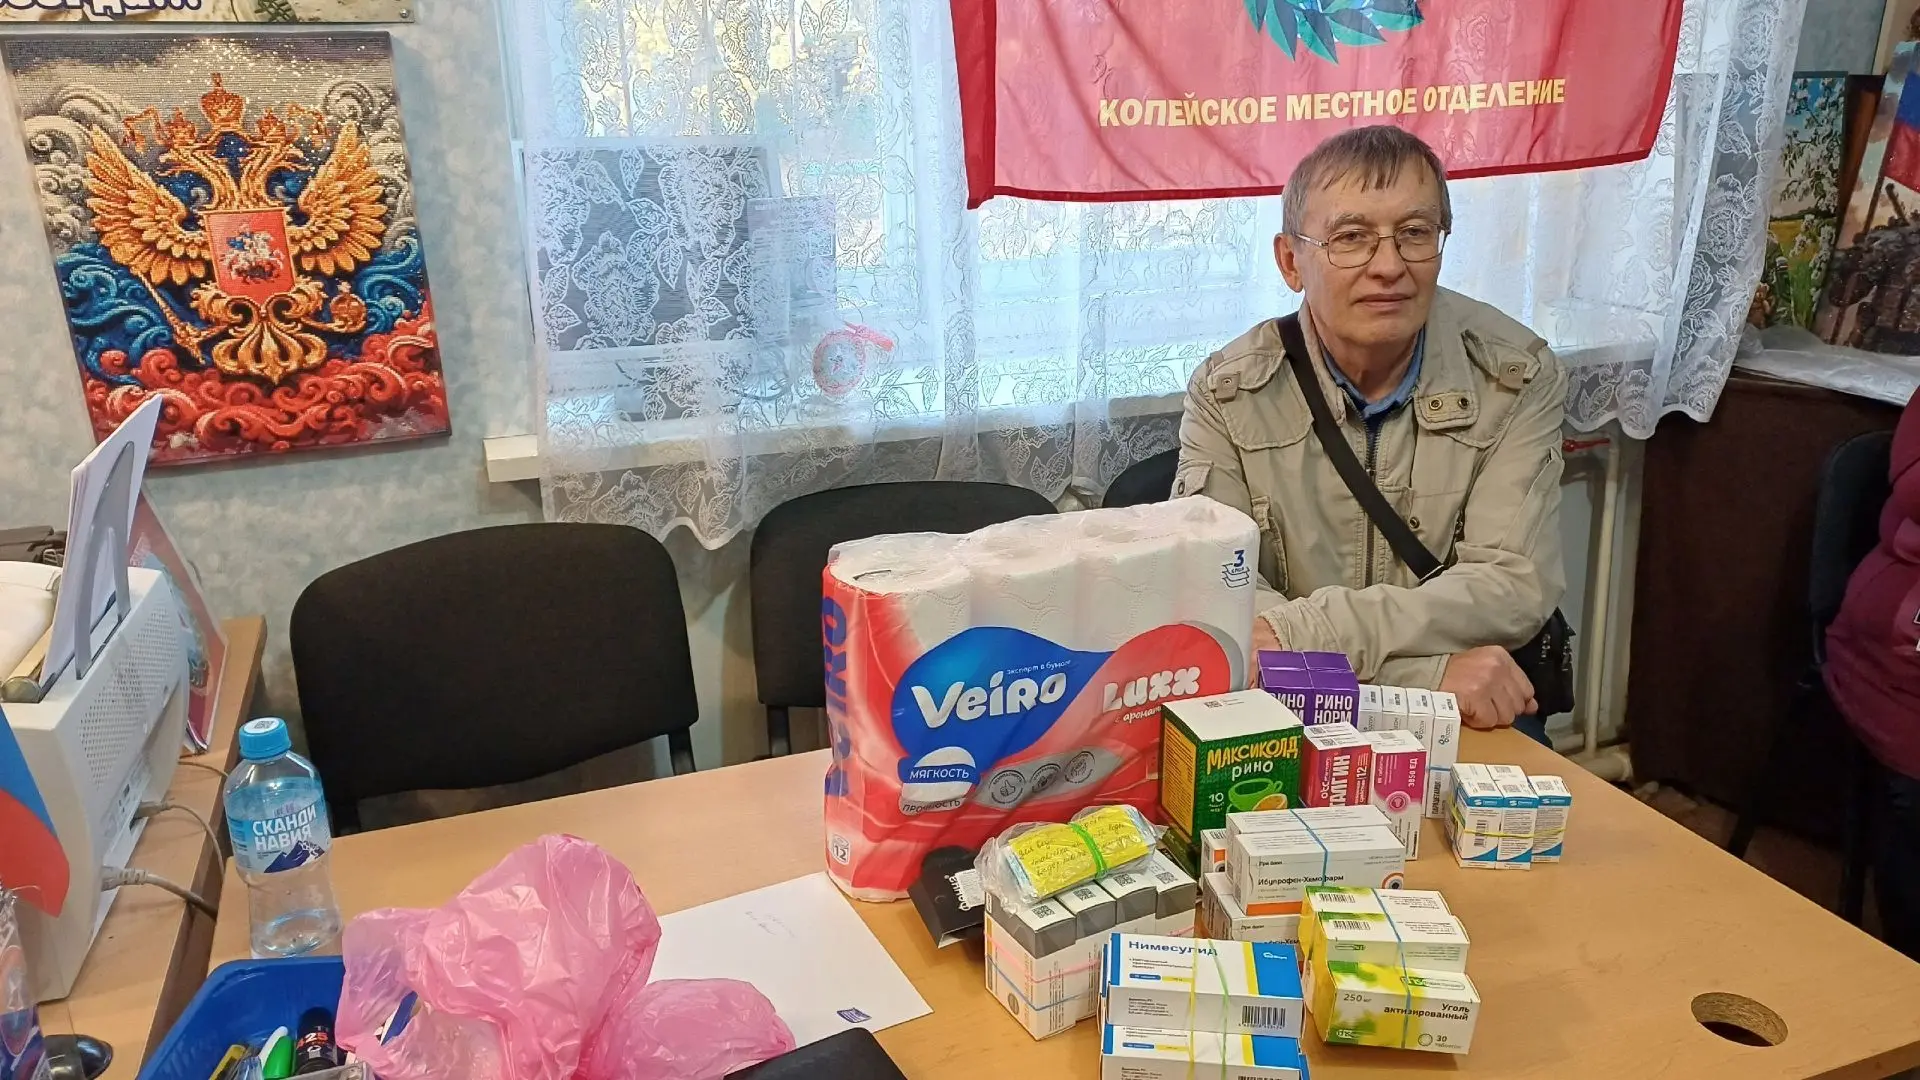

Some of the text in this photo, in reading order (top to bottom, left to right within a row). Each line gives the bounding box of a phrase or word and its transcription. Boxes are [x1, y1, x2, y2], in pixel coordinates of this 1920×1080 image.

[1099, 79, 1566, 127] КОПЕЙСКОЕ МЕСТНОЕ ОТДЕЛЕНИЕ
[1233, 549, 1245, 567] 3
[1315, 694, 1353, 710] РИНО
[1313, 709, 1352, 724] НОРМ
[1206, 735, 1298, 775] МАКСИКОЛД
[1409, 758, 1418, 770] ЕД
[909, 768, 970, 780] МЯГКОСТЬ
[1357, 766, 1368, 778] 12
[1329, 755, 1351, 806] ТАЛГИН
[1208, 792, 1224, 803] 10
[902, 800, 961, 813] ПРОЧНОСТЬ
[252, 804, 317, 836] СКАНДИ
[254, 824, 313, 851] НАВИЯ
[833, 844, 847, 861] 12
[1128, 941, 1218, 956] Нимесулид
[1343, 994, 1362, 1003] 250
[1442, 1003, 1470, 1015] Уголь
